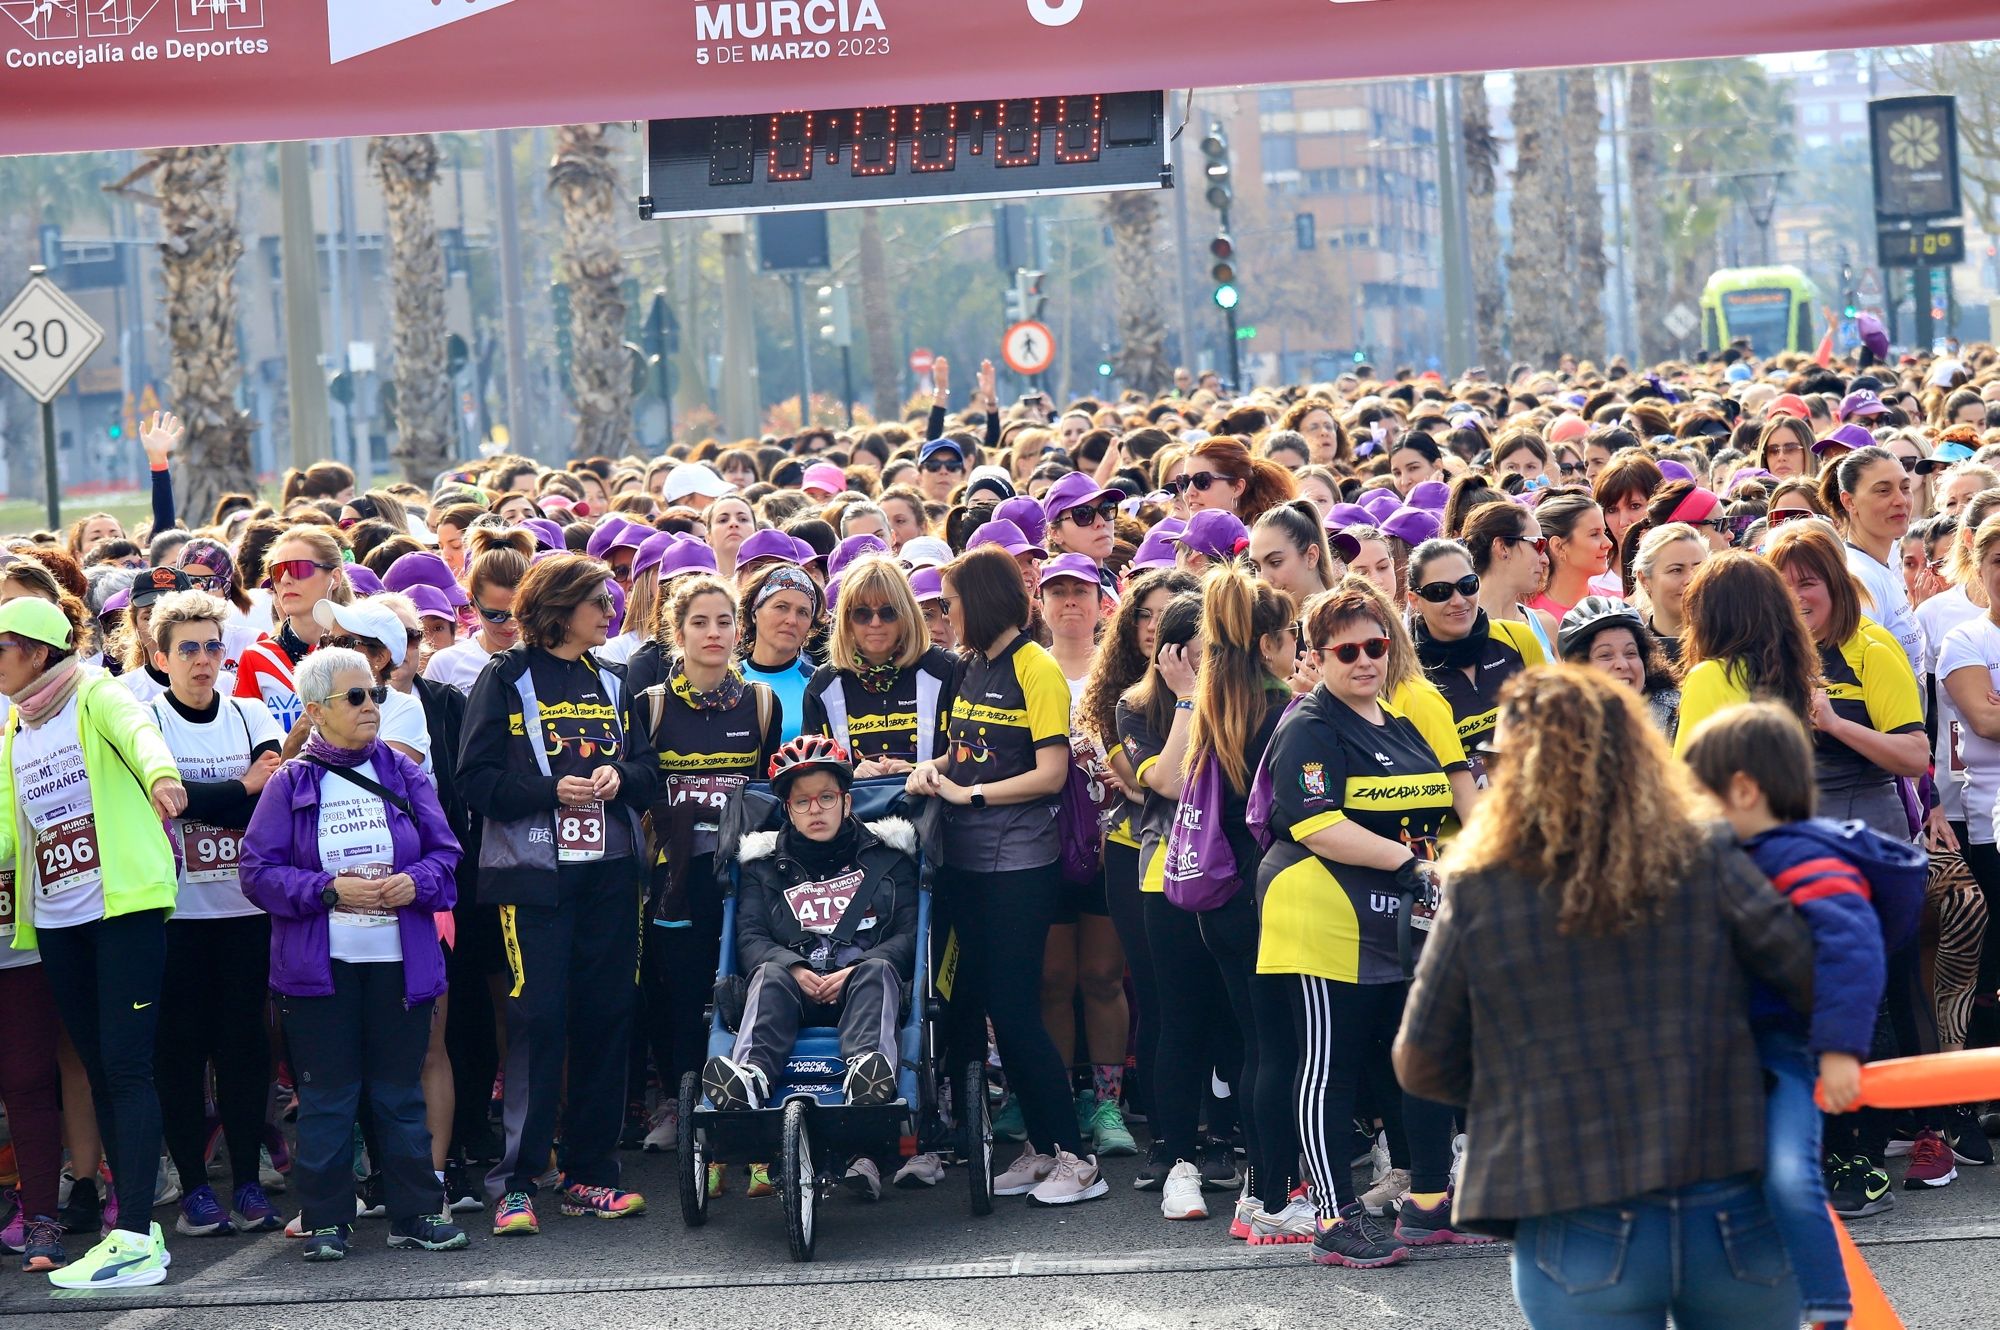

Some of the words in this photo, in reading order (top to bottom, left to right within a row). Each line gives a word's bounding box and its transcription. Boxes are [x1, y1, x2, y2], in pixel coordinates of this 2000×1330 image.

[695, 0, 886, 40] MURCIA
[6, 41, 124, 68] Concejalía
[131, 42, 158, 60] de
[165, 37, 269, 62] Deportes
[696, 48, 710, 64] 5
[717, 46, 745, 64] DE
[751, 40, 831, 61] MARZO
[837, 36, 890, 57] 2023
[13, 318, 68, 361] 30
[1457, 720, 1480, 735] ADAS
[49, 751, 58, 760] LA
[58, 744, 78, 756] MUJER
[61, 755, 83, 771] POR
[201, 765, 217, 778] MÍ
[27, 769, 88, 801] COMPAÑER
[715, 776, 744, 786] MURCIA
[1353, 784, 1420, 801] ZANCADAS
[1421, 783, 1447, 796] SOBRE
[320, 799, 351, 809] CARRERA
[323, 811, 346, 822] POR
[347, 805, 364, 819] MÍ
[330, 816, 387, 835] COMPAÑ
[559, 817, 601, 843] 83
[43, 837, 94, 876] 296
[829, 875, 861, 889] MURCIA
[798, 892, 855, 921] 479
[1370, 893, 1401, 914] UP
[786, 1060, 827, 1068] Advance
[794, 1065, 832, 1074] Mobility
